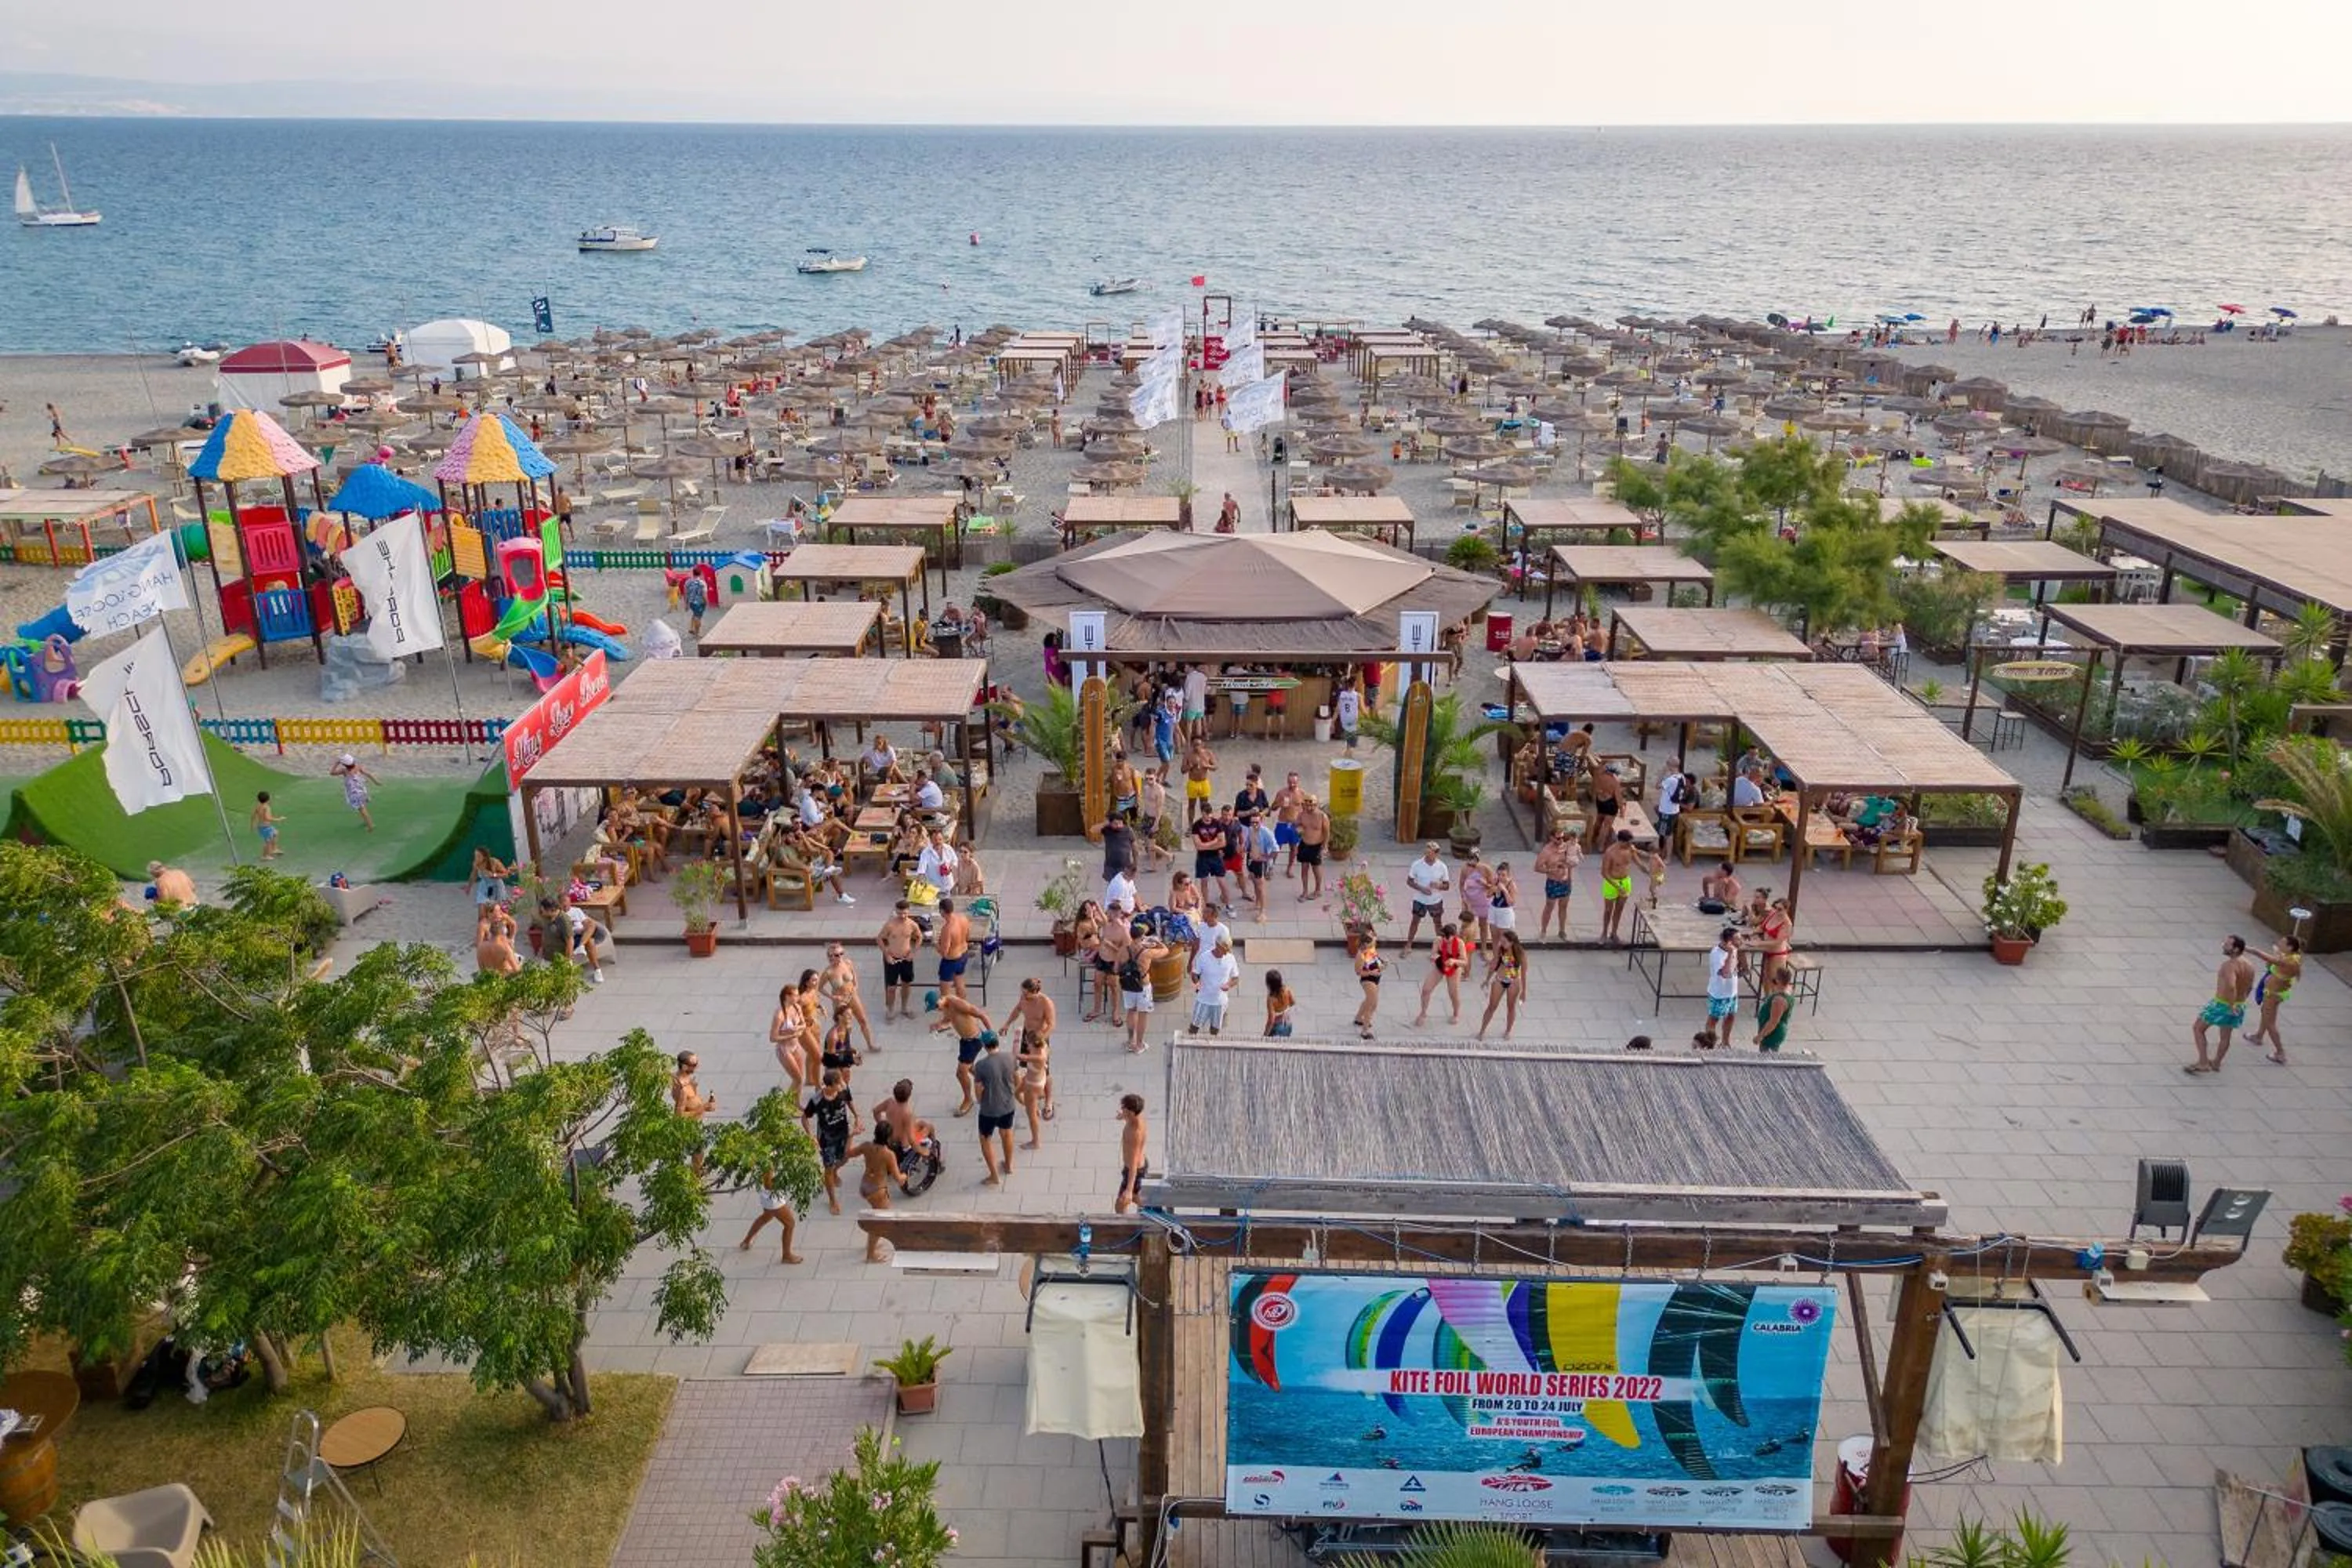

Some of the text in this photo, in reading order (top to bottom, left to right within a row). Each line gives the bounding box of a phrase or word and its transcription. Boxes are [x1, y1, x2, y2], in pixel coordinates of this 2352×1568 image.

[1754, 1323, 1802, 1332] CALABRIA
[1390, 1370, 1663, 1400] KITE FOIL WORLD SERIES 2022
[1472, 1399, 1583, 1413] FROM 20 TO 24 JULY
[1512, 1417, 1541, 1427] YOUTH
[1541, 1418, 1560, 1428] FOIL
[1469, 1427, 1584, 1439] EUROPEAN CHAMPIONSHIP
[1479, 1497, 1553, 1509] HANG LOOSE
